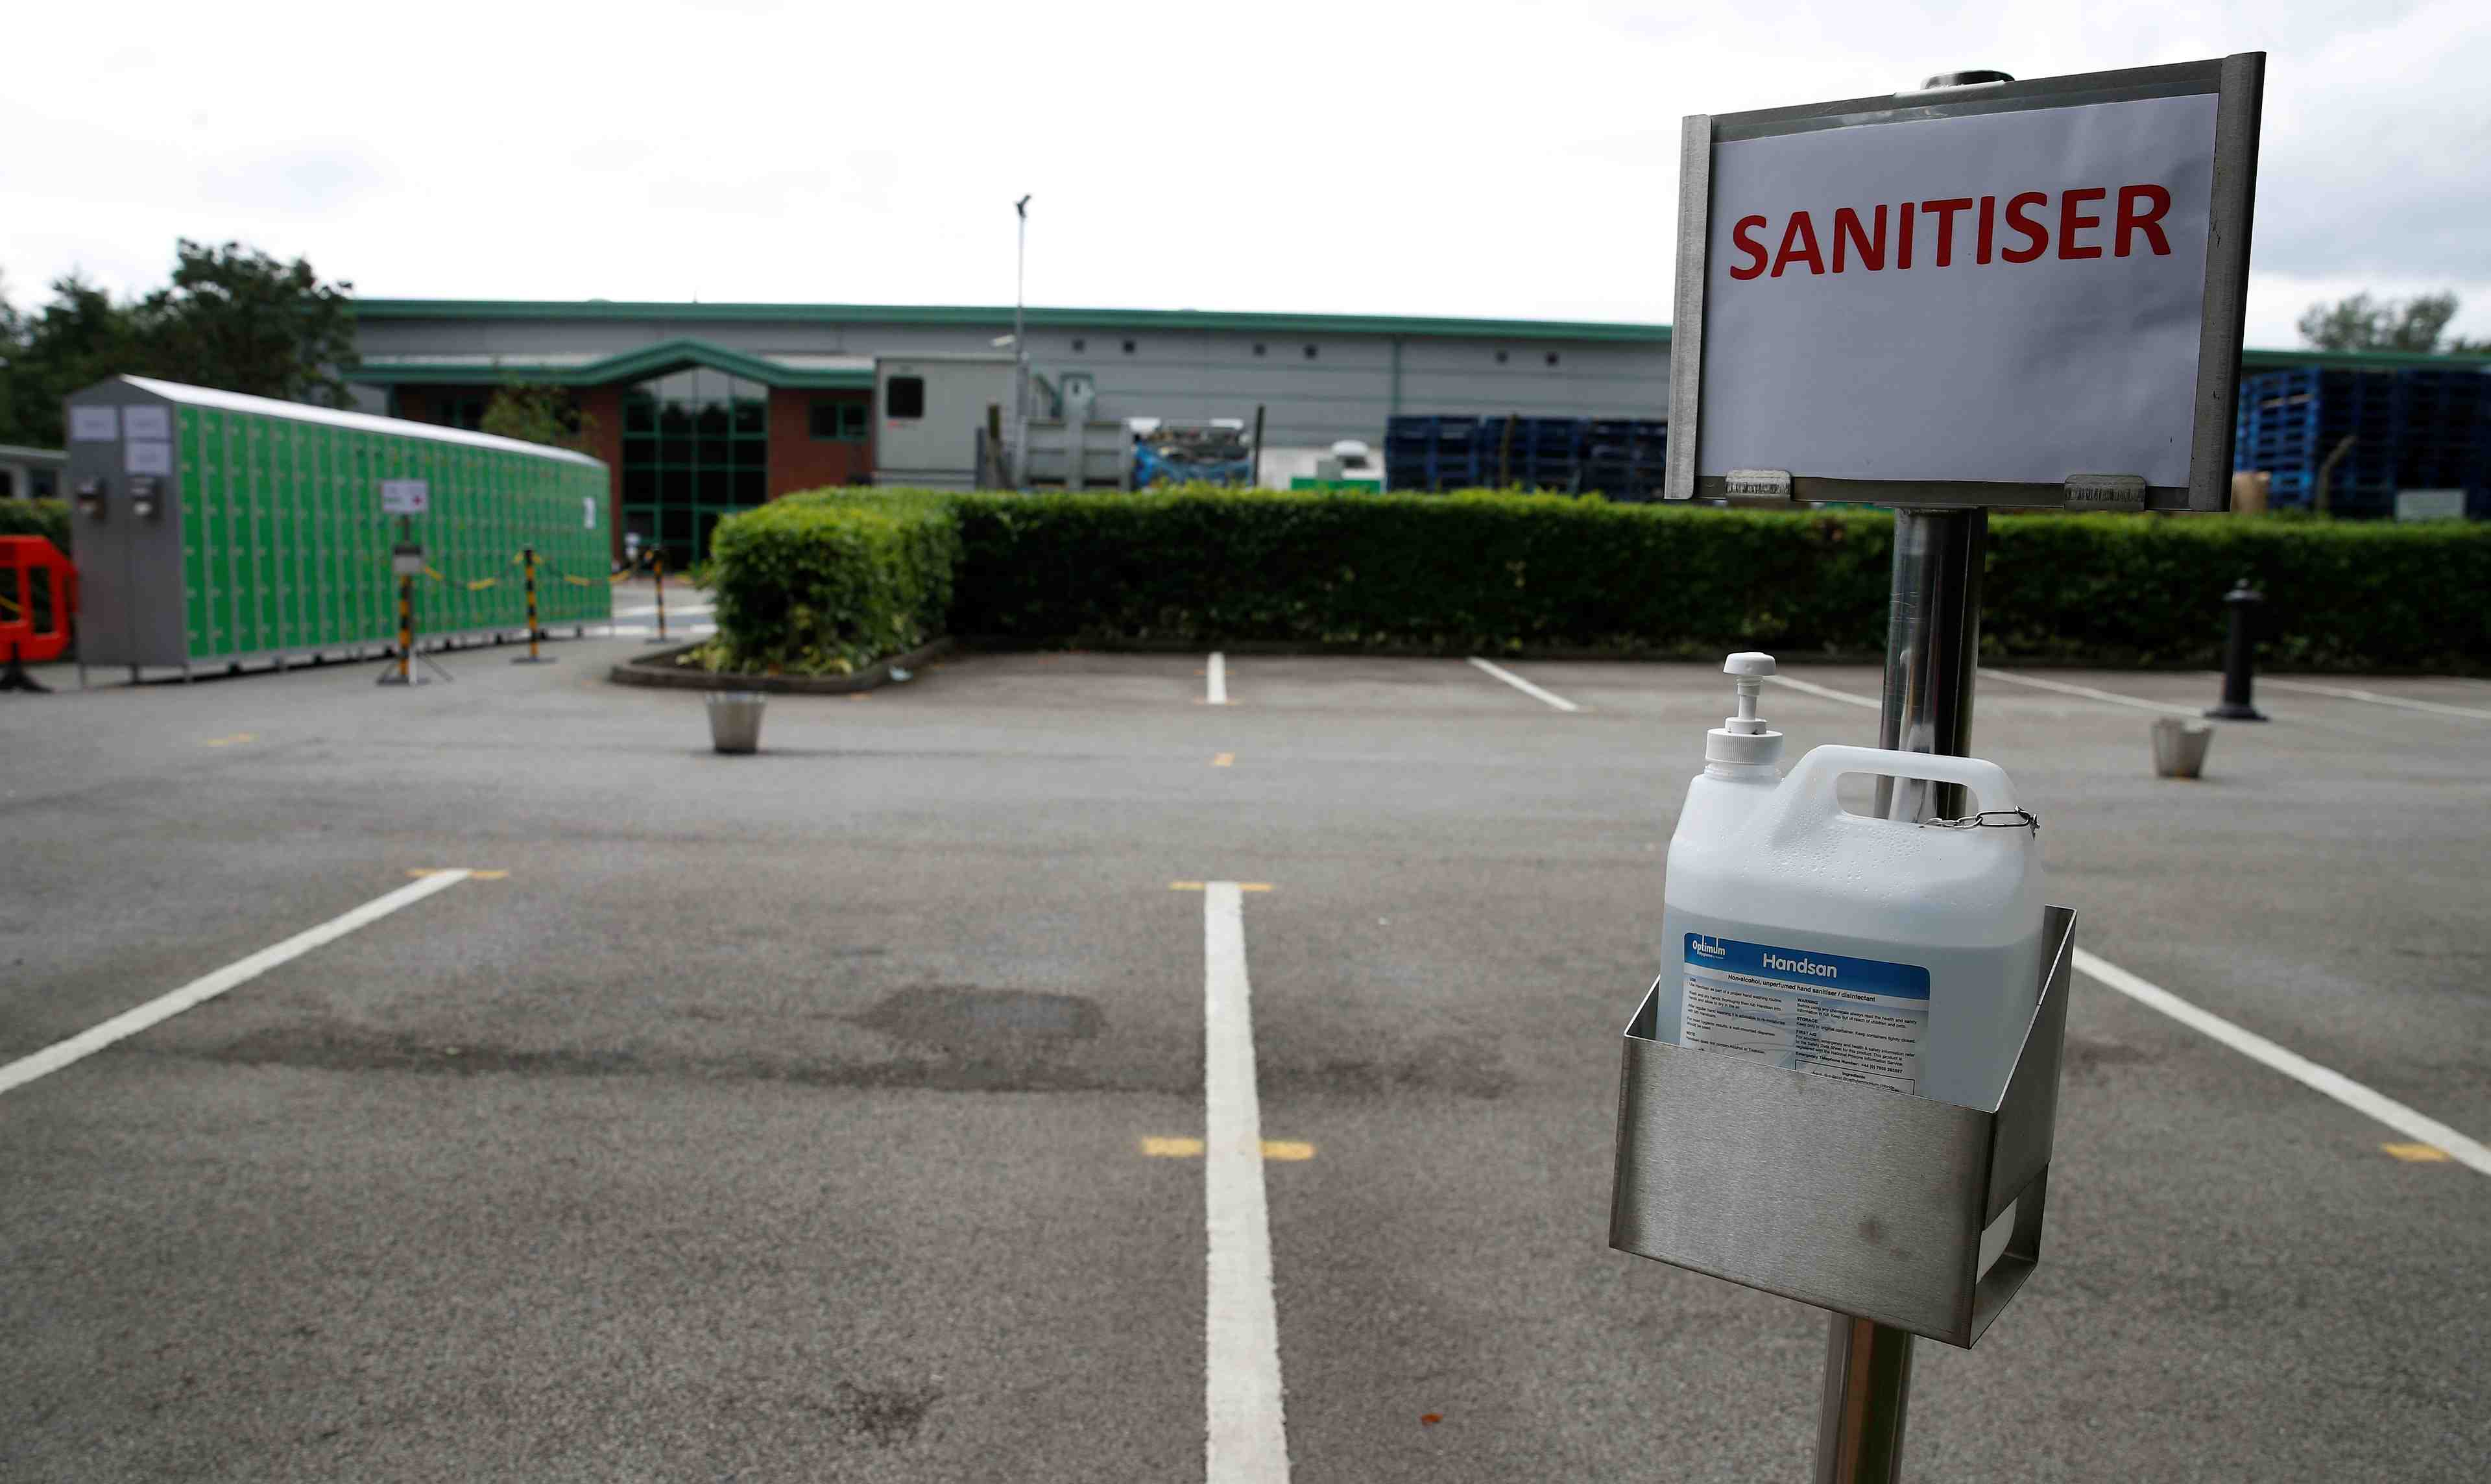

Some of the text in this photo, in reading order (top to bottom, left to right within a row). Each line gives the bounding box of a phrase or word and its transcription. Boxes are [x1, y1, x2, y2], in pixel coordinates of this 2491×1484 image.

[1729, 184, 2171, 281] SANITISER
[1692, 935, 1726, 955] Optimum
[1763, 953, 1838, 979] Handsan
[1727, 974, 1761, 985] Non-alcohol,
[1763, 980, 1796, 990] unperfumed
[1797, 985, 1811, 993] hand
[1812, 987, 1837, 997] sanitiser
[1841, 992, 1875, 1002] disinfectant
